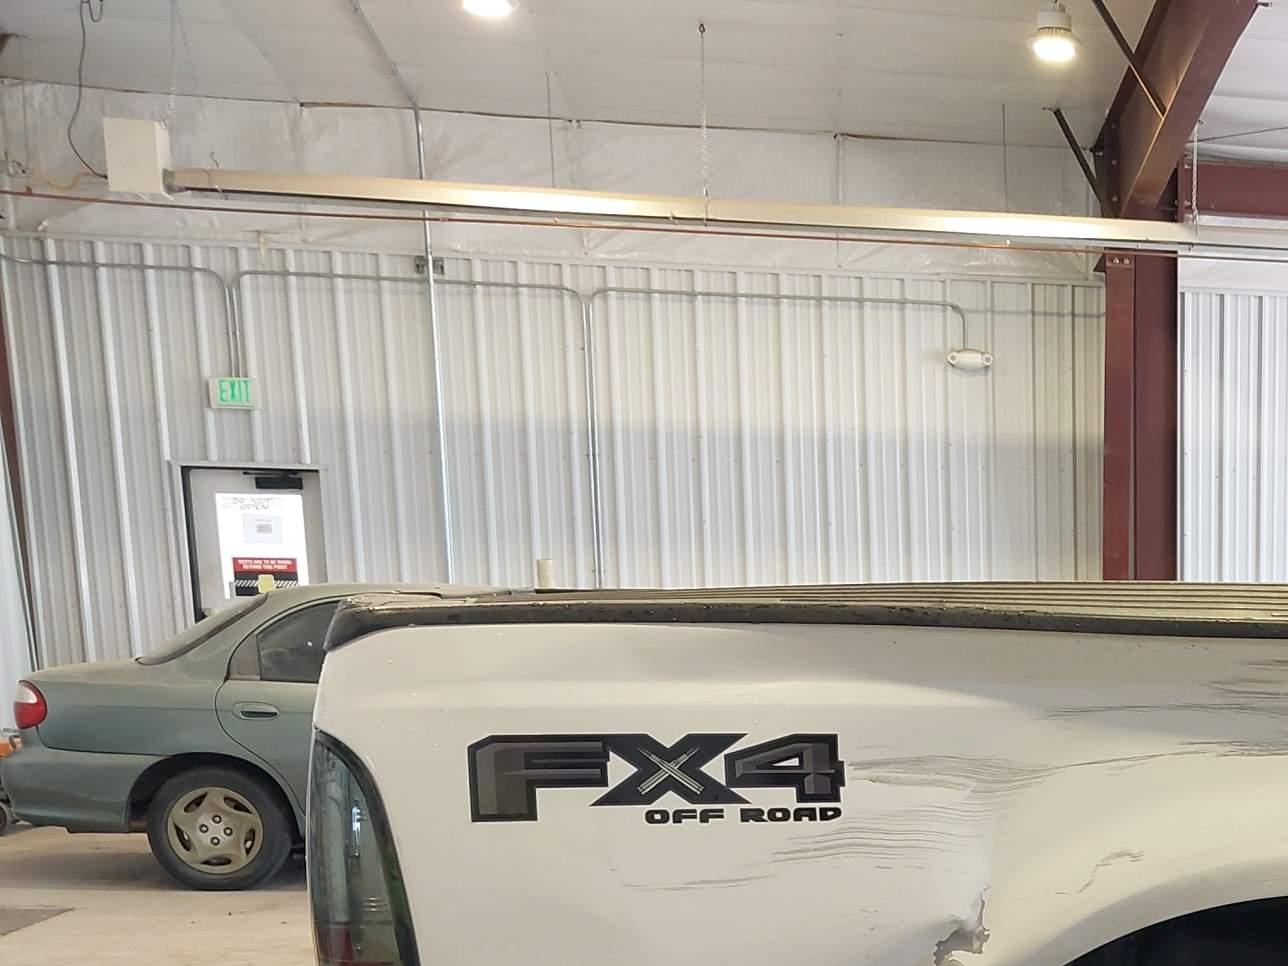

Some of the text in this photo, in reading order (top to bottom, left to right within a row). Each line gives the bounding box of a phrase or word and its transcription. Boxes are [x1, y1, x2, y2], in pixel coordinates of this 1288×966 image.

[219, 379, 250, 401] EXIT
[467, 733, 846, 823] FX4
[645, 807, 842, 824] OFF ROAD
